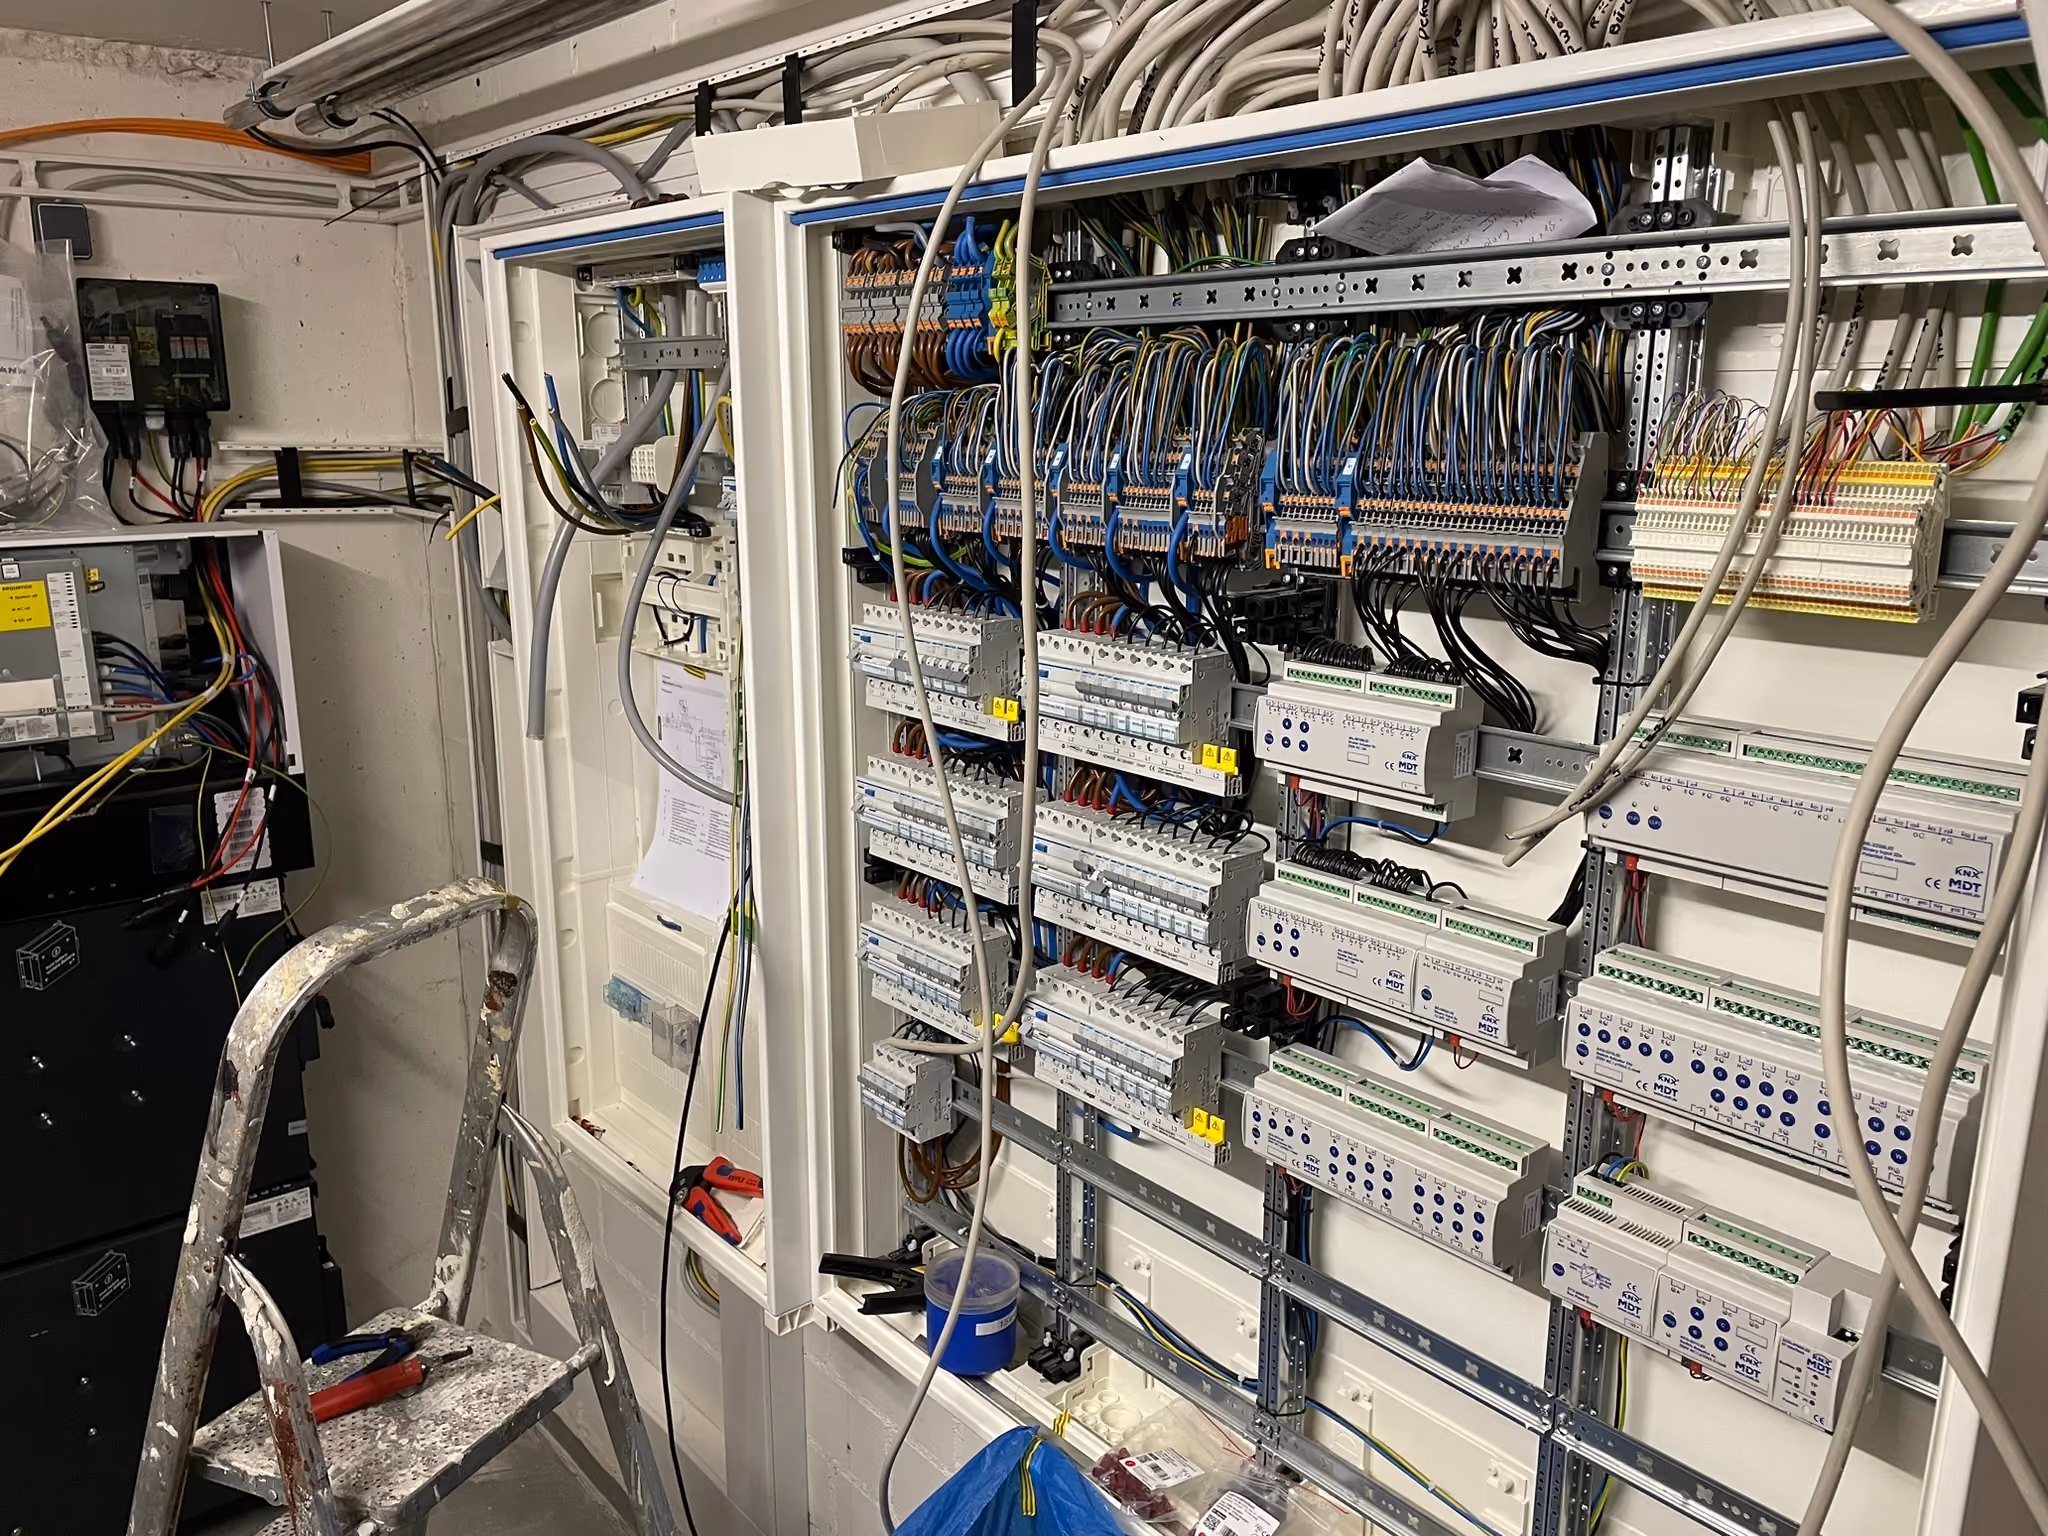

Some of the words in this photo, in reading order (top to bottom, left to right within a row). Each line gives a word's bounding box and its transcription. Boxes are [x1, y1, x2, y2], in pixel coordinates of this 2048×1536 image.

[1399, 761, 1418, 771] MDT
[1955, 867, 1981, 879] KNX
[1949, 878, 1982, 893] MDT
[1386, 978, 1404, 990] MDT
[1478, 1022, 1499, 1035] MDT
[1659, 1074, 1678, 1085] KNX
[1654, 1082, 1678, 1097] MDT
[1304, 1161, 1320, 1174] MDT
[1622, 1292, 1640, 1304] KNX
[1618, 1298, 1641, 1315] MDT
[1740, 1354, 1760, 1367] KNX
[1807, 1358, 1832, 1374] MDT
[1735, 1361, 1761, 1378] MDT
